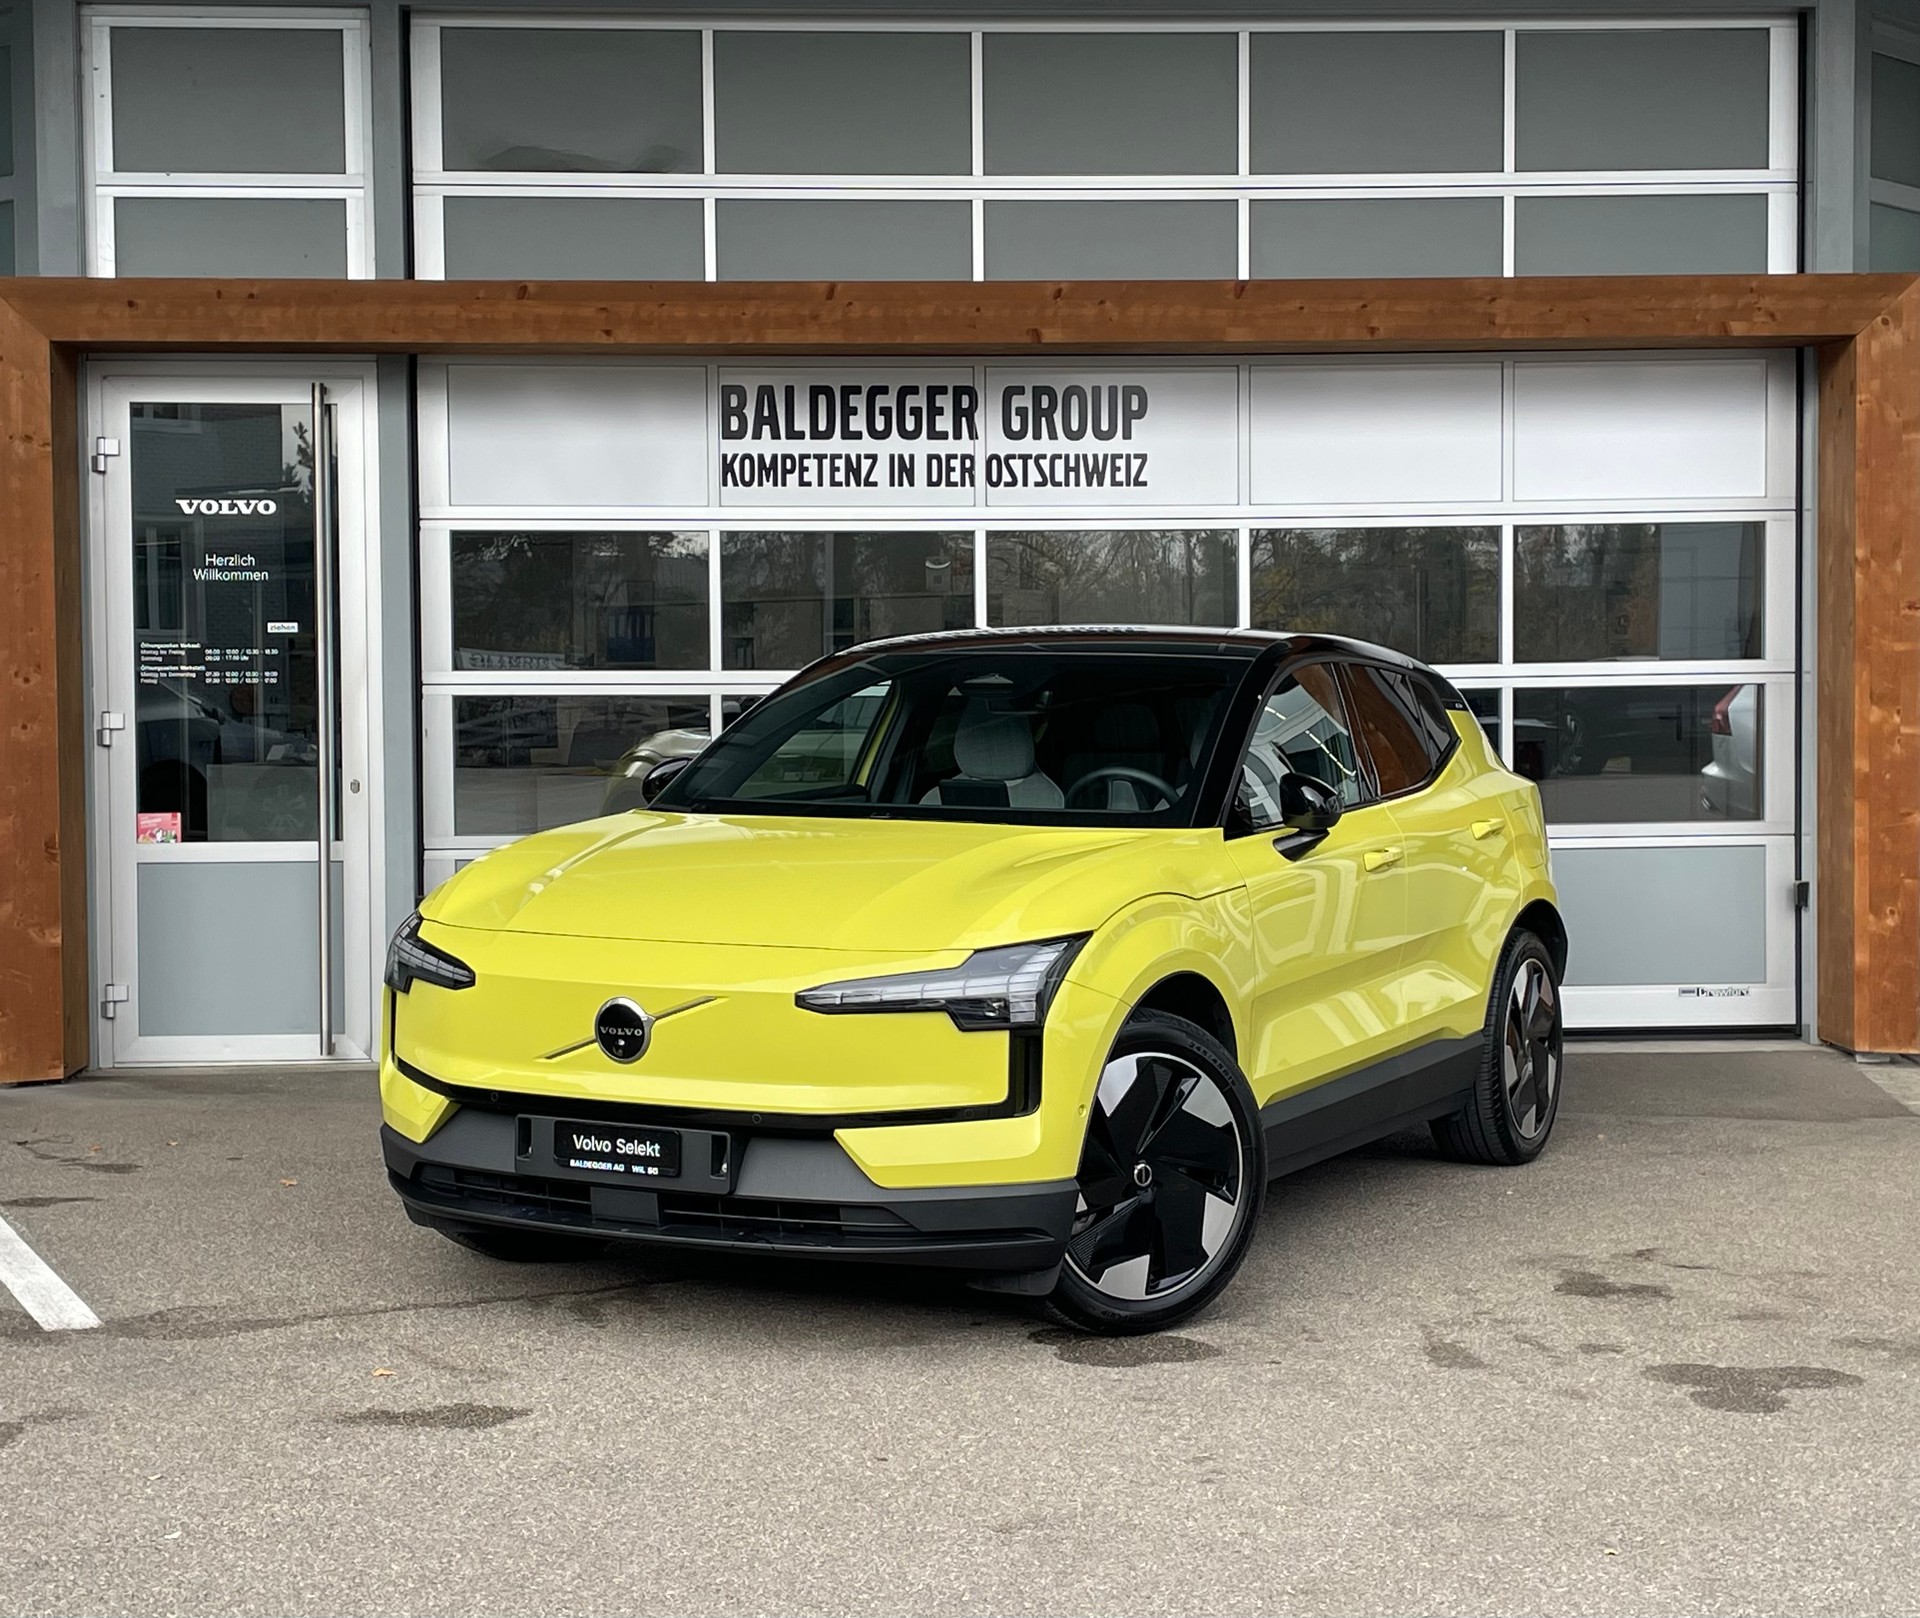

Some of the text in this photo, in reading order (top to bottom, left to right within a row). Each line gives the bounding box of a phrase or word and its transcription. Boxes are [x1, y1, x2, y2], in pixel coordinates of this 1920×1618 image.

[720, 384, 1149, 441] BALDEGGER GROUP
[720, 453, 1149, 488] KOMPETENZ IN DER OSTSCHWEIZ
[175, 499, 277, 515] VOLVO
[205, 553, 256, 567] Herzlich
[193, 568, 269, 581] Willkommen
[600, 1026, 643, 1037] VOLVO
[572, 1134, 660, 1158] Volvo Selekt
[569, 1159, 612, 1170] BALDEGGER
[613, 1163, 625, 1172] AG
[647, 1166, 659, 1175] SG
